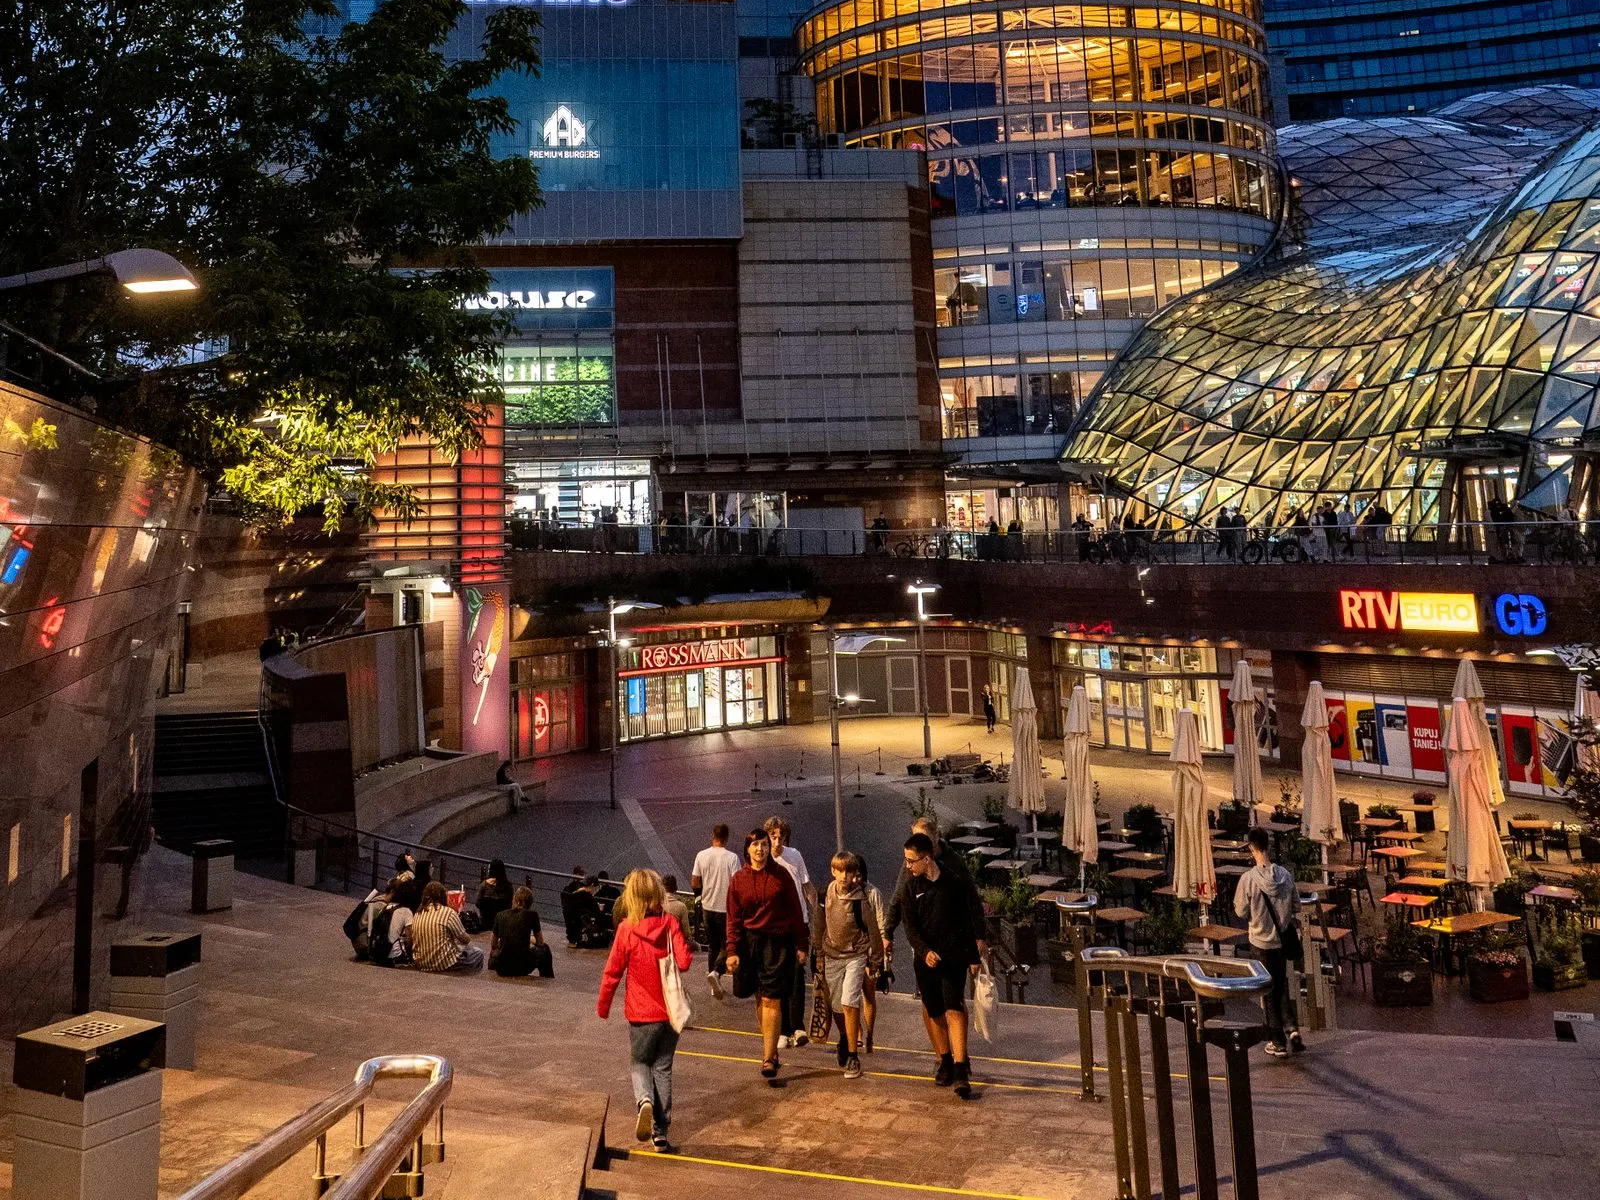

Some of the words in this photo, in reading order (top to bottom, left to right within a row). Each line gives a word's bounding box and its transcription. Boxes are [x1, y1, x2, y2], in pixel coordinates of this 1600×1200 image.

[529, 150, 563, 159] PREMIUM
[564, 150, 599, 159] BURGERS
[1340, 590, 1399, 629] RTV
[1403, 602, 1471, 621] EURO
[642, 641, 747, 669] ROSSMANN
[1413, 727, 1438, 739] KUPUJ
